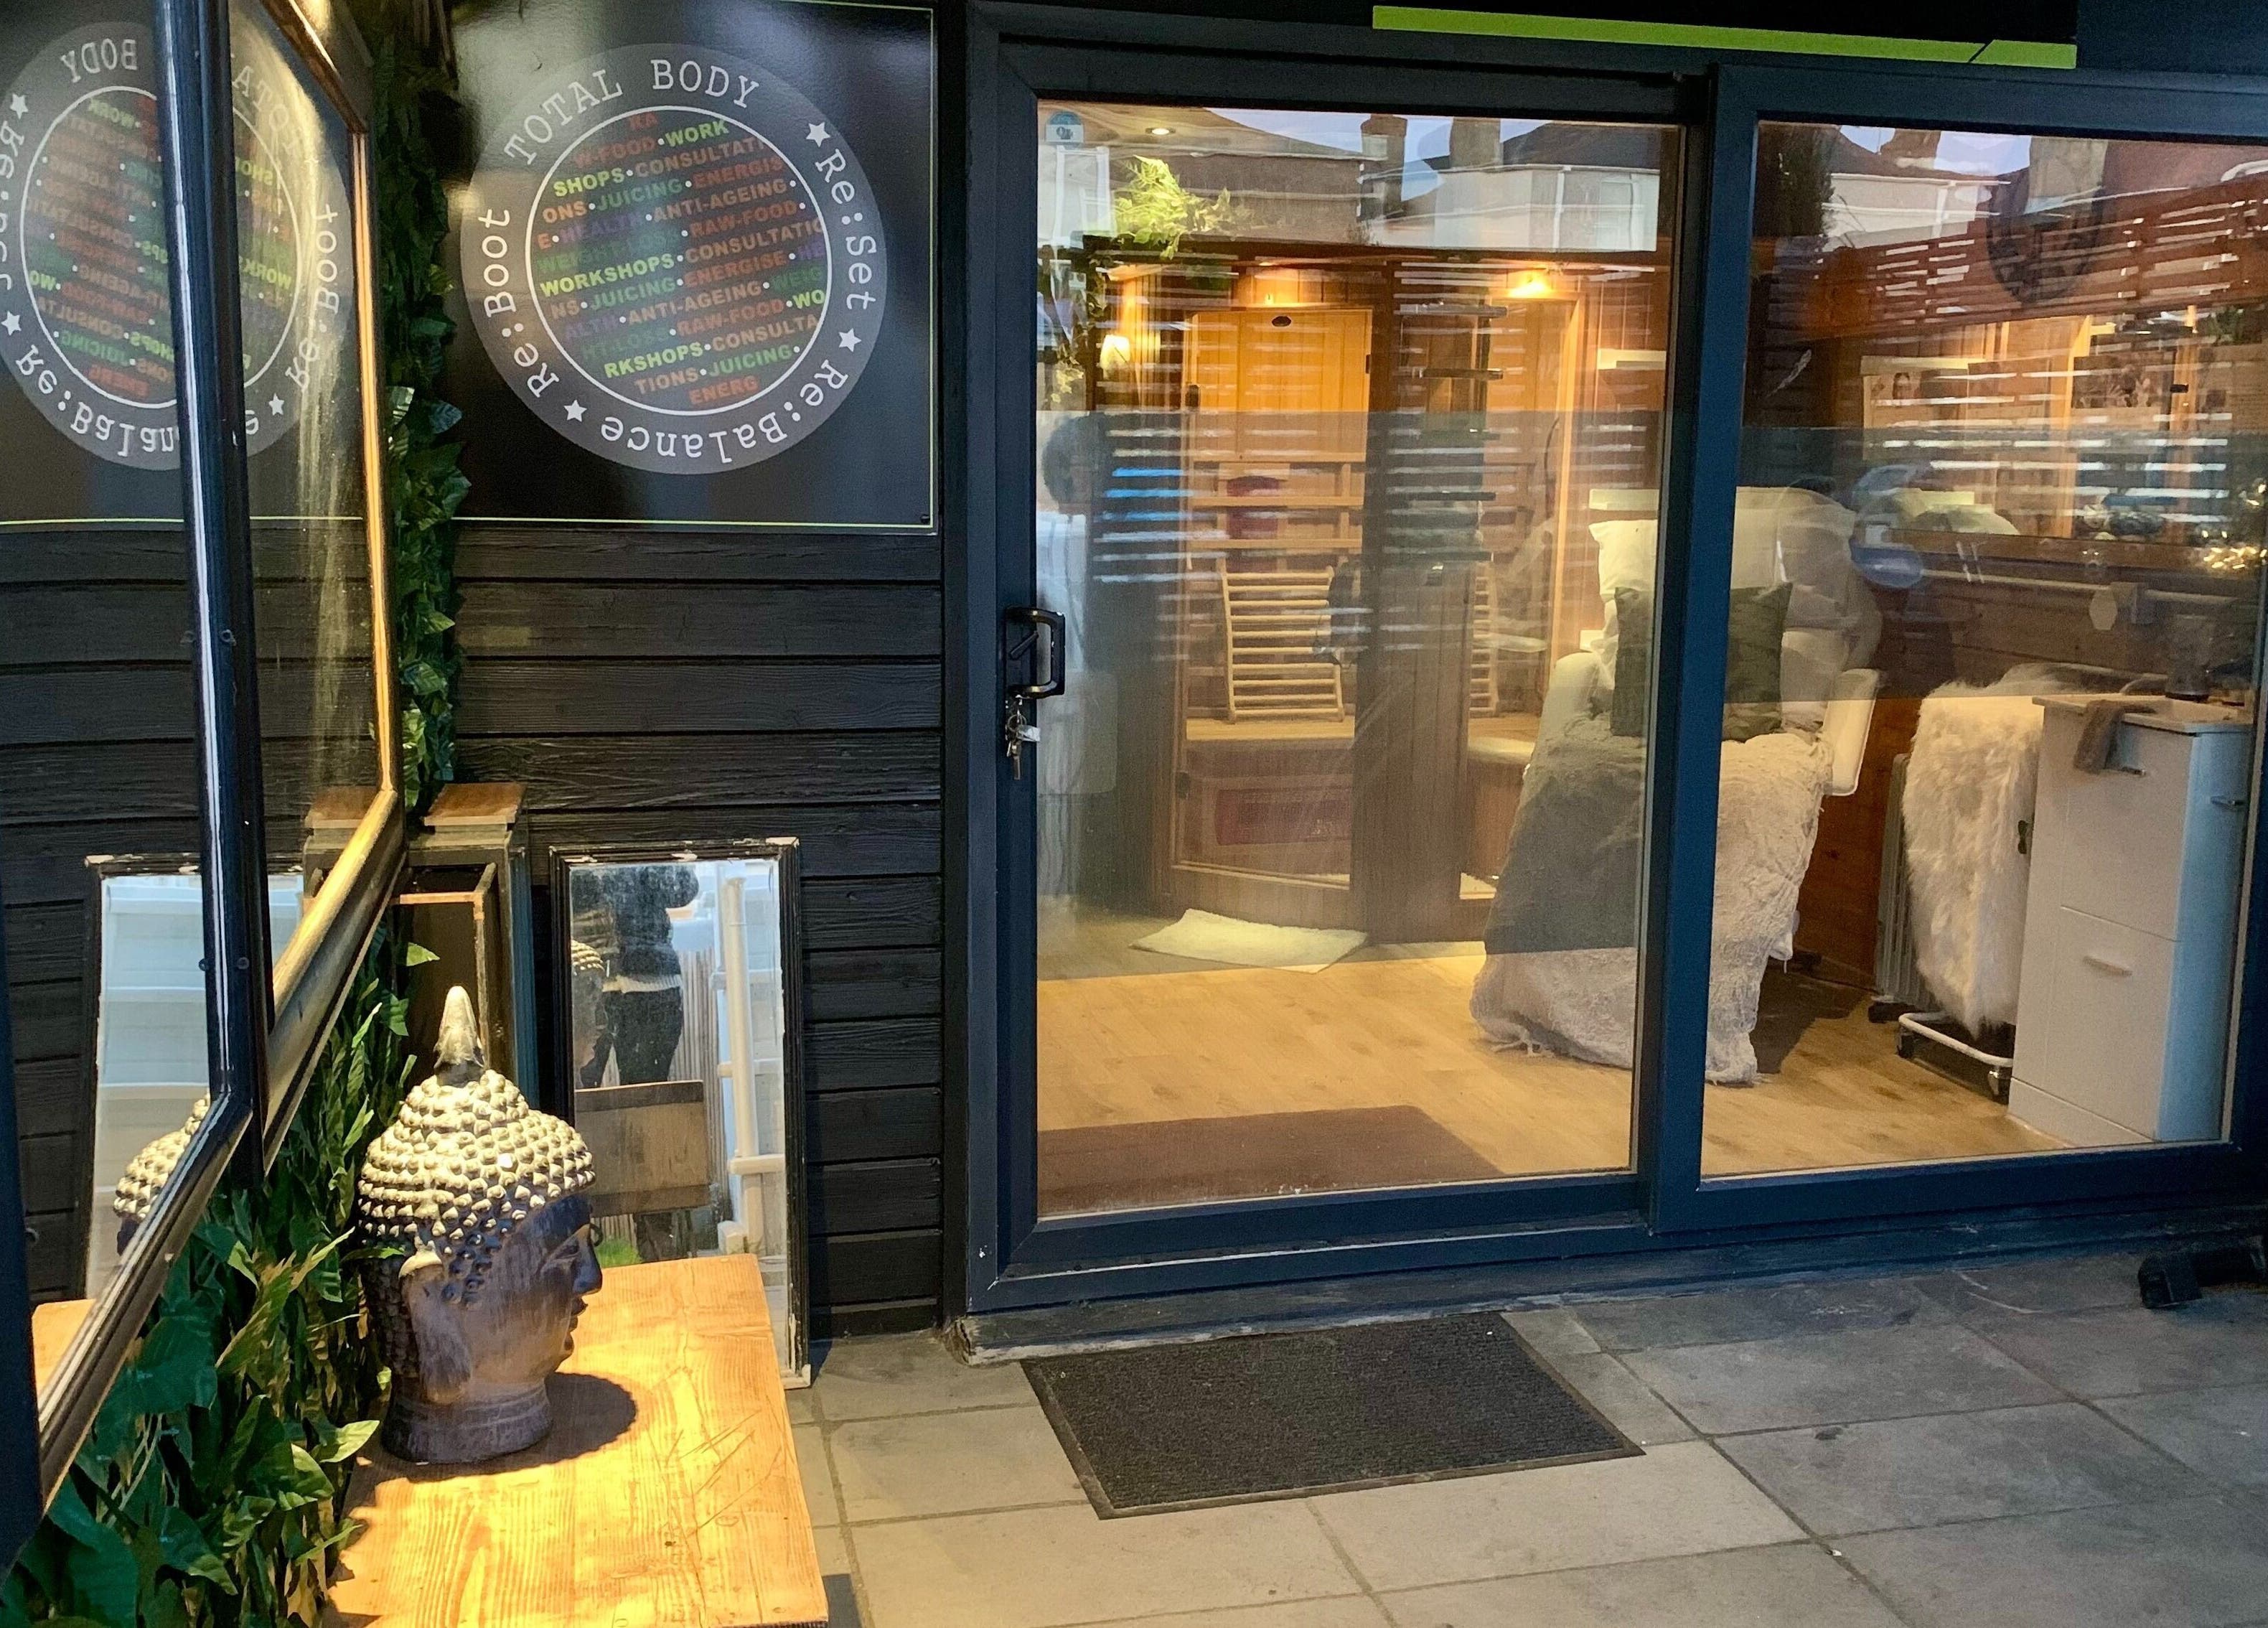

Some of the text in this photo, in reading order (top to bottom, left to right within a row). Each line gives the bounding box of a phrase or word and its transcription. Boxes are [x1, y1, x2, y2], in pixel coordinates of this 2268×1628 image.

[504, 60, 759, 166] TOTAL BODY
[665, 120, 730, 147] WORK
[542, 200, 588, 225] ONS
[596, 177, 683, 212] JUICING
[553, 167, 625, 198] SHOPS
[652, 177, 787, 223] ANTI-AGEING
[689, 200, 798, 238] RAW-FOOD
[815, 150, 878, 311] Re:Set
[540, 253, 675, 298] WORKSHOPS
[589, 276, 676, 312] JUICING
[683, 250, 787, 289] ENERGISE
[479, 209, 559, 398] Re:Boot
[628, 280, 762, 327] ANTI-AGEING
[677, 299, 784, 337] RAW-FOOD
[792, 289, 825, 310] WO
[604, 313, 820, 379] RKSHOPS CONSULTA
[634, 344, 793, 396] TIONS JUICING
[601, 360, 849, 464] Re:Balance
[688, 375, 761, 405] ENERG
